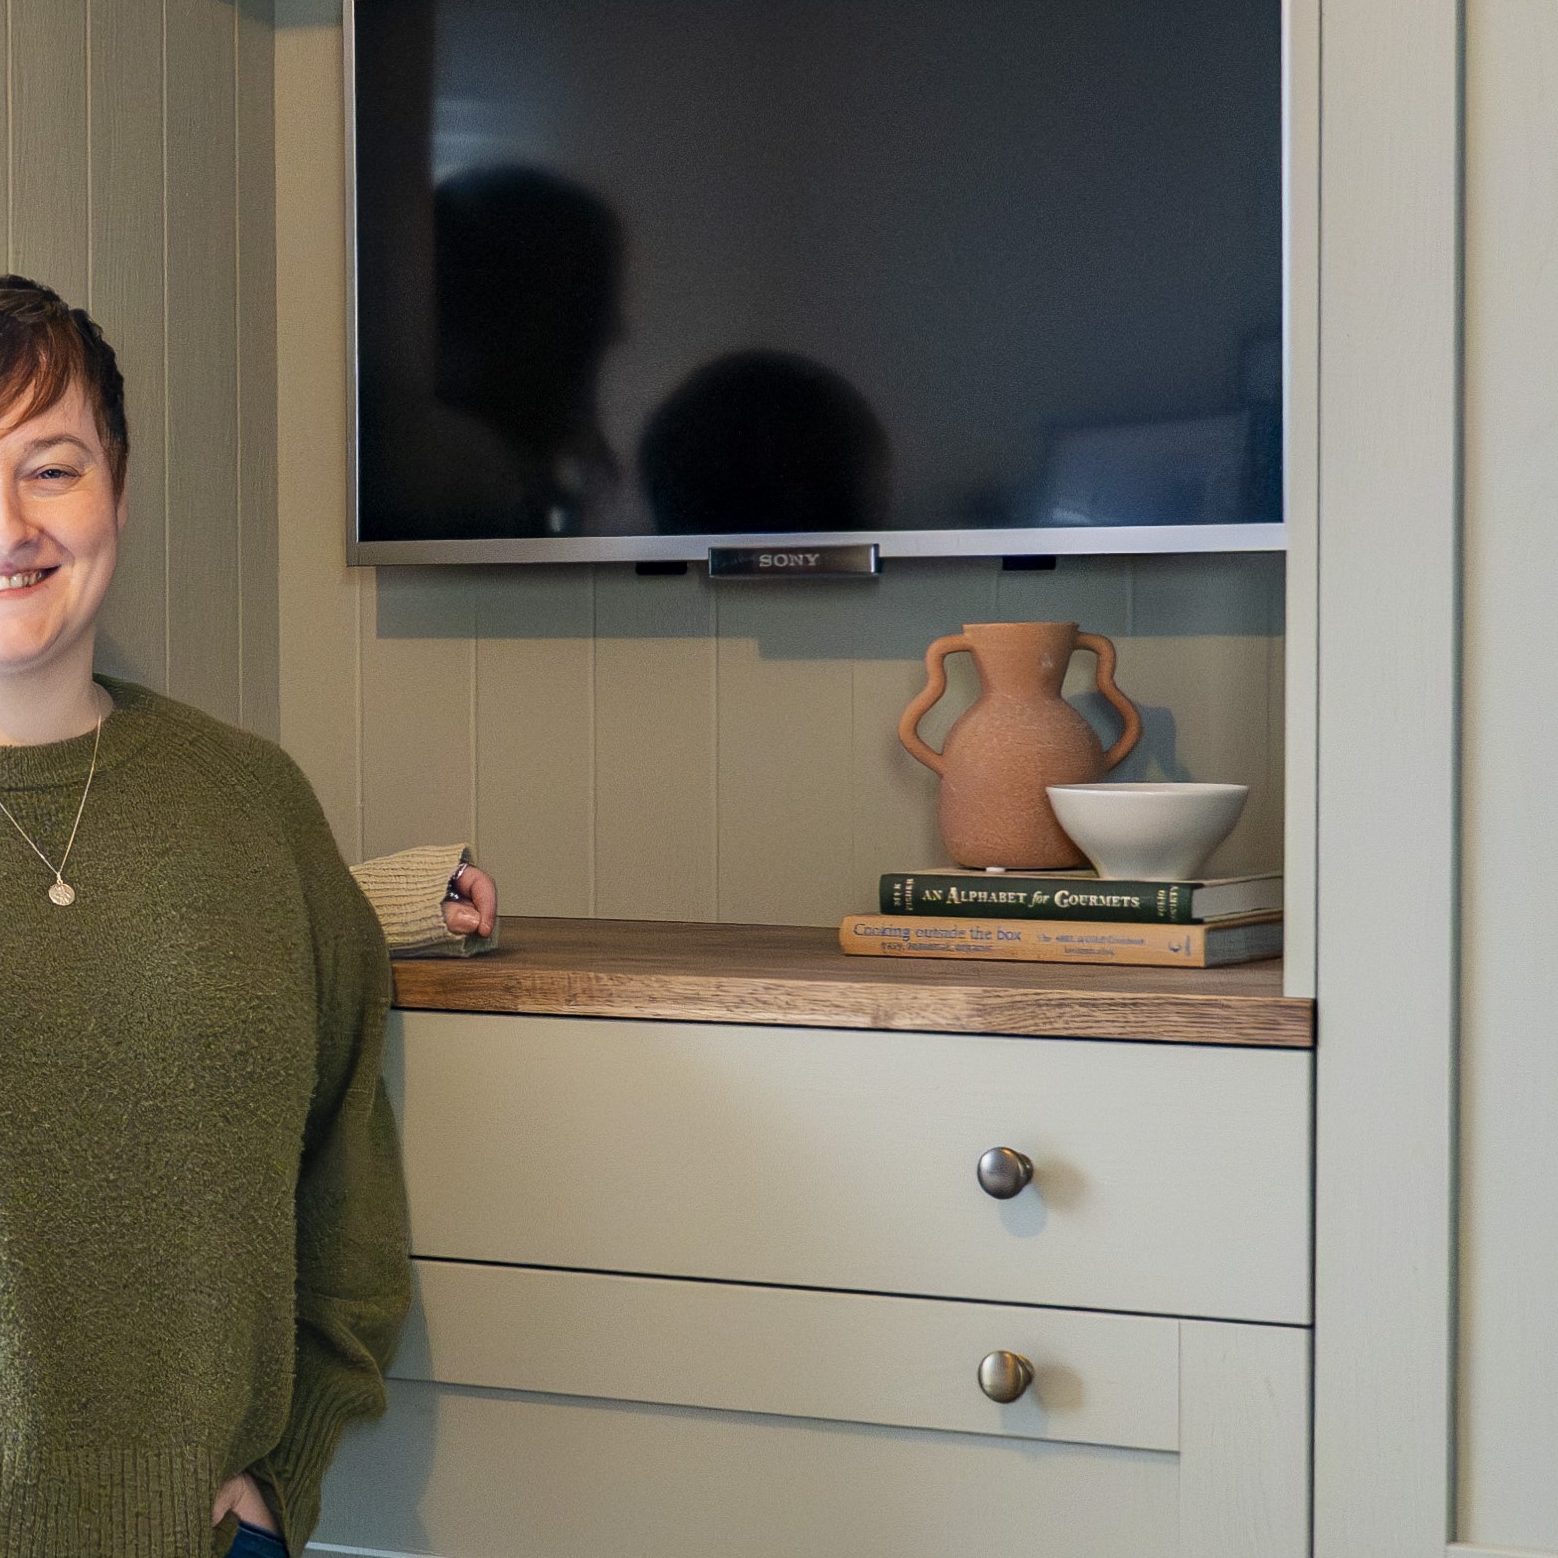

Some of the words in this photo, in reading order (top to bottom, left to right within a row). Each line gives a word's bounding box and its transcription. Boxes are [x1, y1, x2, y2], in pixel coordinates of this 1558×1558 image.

[759, 553, 820, 567] SONY
[922, 889, 943, 901] AN
[946, 886, 1027, 904] ALPHABET
[1028, 890, 1050, 908] for
[1054, 889, 1141, 908] GOURMETS
[853, 923, 911, 942] Cooking
[914, 924, 967, 939] outside
[970, 926, 992, 940] the
[997, 925, 1022, 941] box
